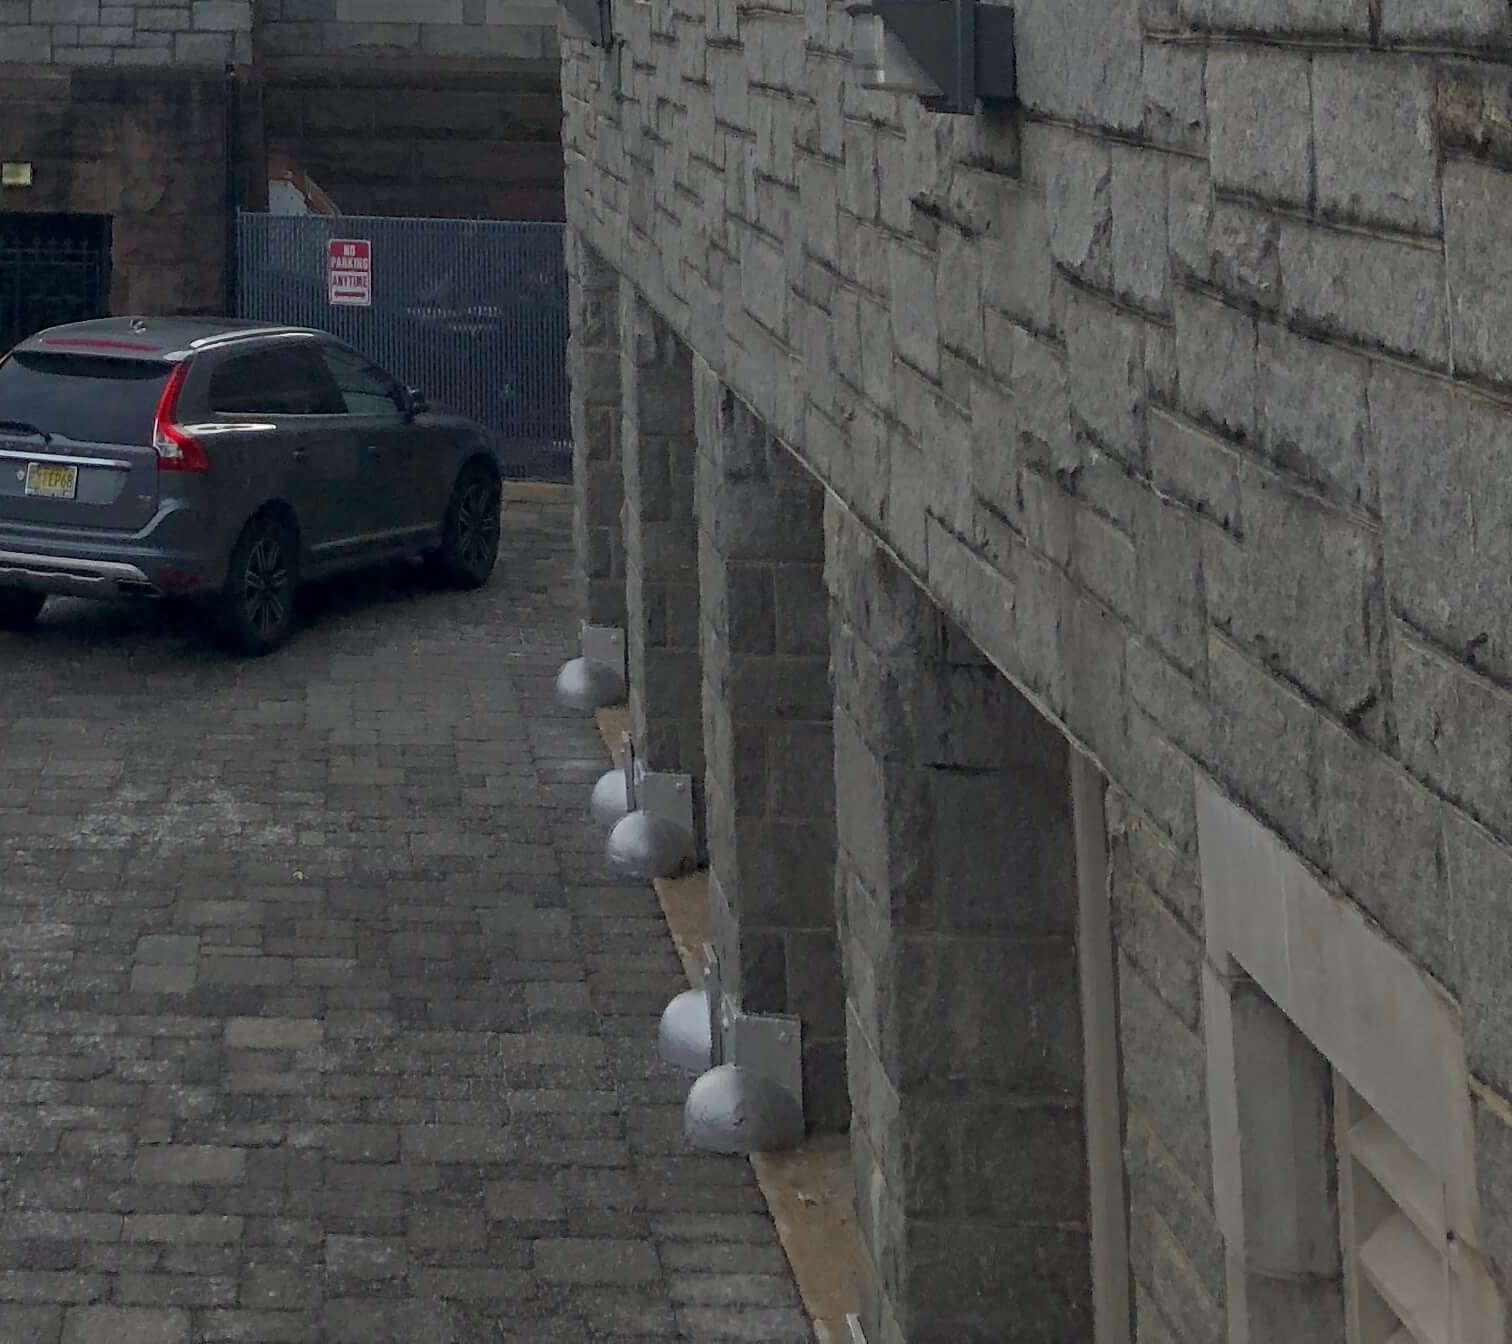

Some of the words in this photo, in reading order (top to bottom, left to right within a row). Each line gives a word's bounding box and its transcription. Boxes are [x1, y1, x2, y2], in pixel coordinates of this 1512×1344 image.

[343, 244, 356, 257] NO
[331, 256, 369, 270] PARKING
[332, 274, 369, 288] ANYTIME
